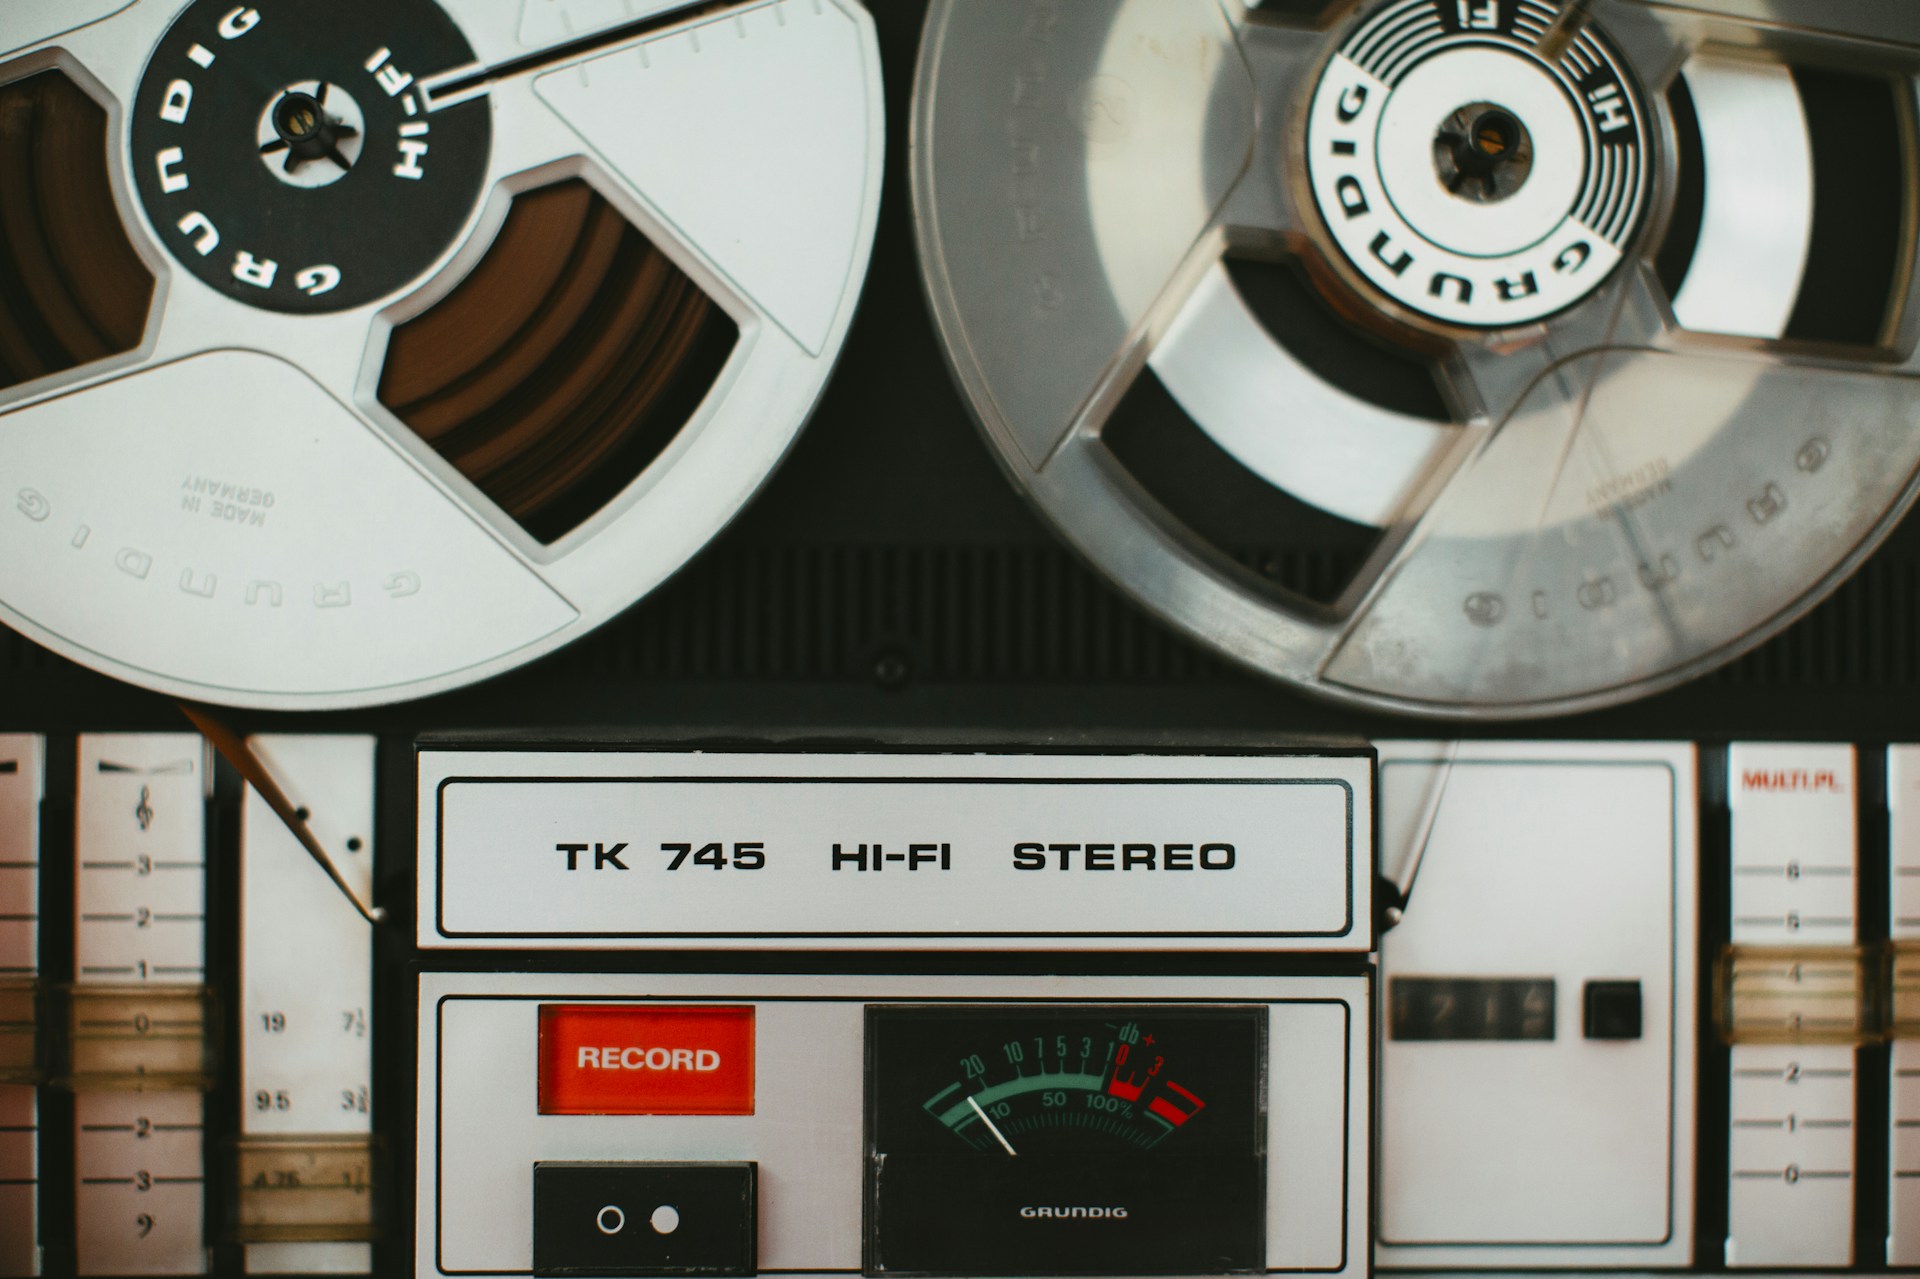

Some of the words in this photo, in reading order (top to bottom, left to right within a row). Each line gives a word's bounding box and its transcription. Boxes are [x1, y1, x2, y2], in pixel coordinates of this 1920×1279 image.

[364, 46, 430, 180] HI-FI
[157, 5, 341, 296] GRUNDIG
[1331, 84, 1592, 304] GRUNDIG
[181, 474, 275, 508] GERMANY
[210, 500, 266, 527] MADE
[16, 487, 422, 608] GRUNDIG
[137, 855, 151, 877] 3
[556, 843, 630, 871] TK
[660, 843, 766, 871] 745
[831, 843, 951, 871] HI-FI
[1012, 843, 1236, 871] STEREO
[137, 907, 151, 928] 2
[137, 961, 148, 980] 1
[135, 1013, 149, 1034] 0
[261, 1010, 286, 1032] 19
[577, 1046, 721, 1071] RECORD
[960, 1054, 986, 1079] 20
[1003, 1041, 1024, 1063] 10
[1034, 1037, 1043, 1059] 7
[1056, 1036, 1067, 1057] 5
[1080, 1037, 1092, 1058] 3
[1105, 1041, 1115, 1062] 1
[1115, 1044, 1130, 1066] 0
[1147, 1055, 1165, 1077] 3
[1786, 1062, 1800, 1083] 2
[256, 1090, 291, 1111] 9.5
[990, 1102, 1011, 1120] 10
[1042, 1092, 1067, 1107] 50
[1086, 1094, 1133, 1120] 100%
[136, 1117, 151, 1138] 2
[1786, 1114, 1796, 1133] 1
[136, 1171, 151, 1192] 3
[1784, 1165, 1799, 1186] 0
[1020, 1206, 1129, 1218] GRUNDIG
